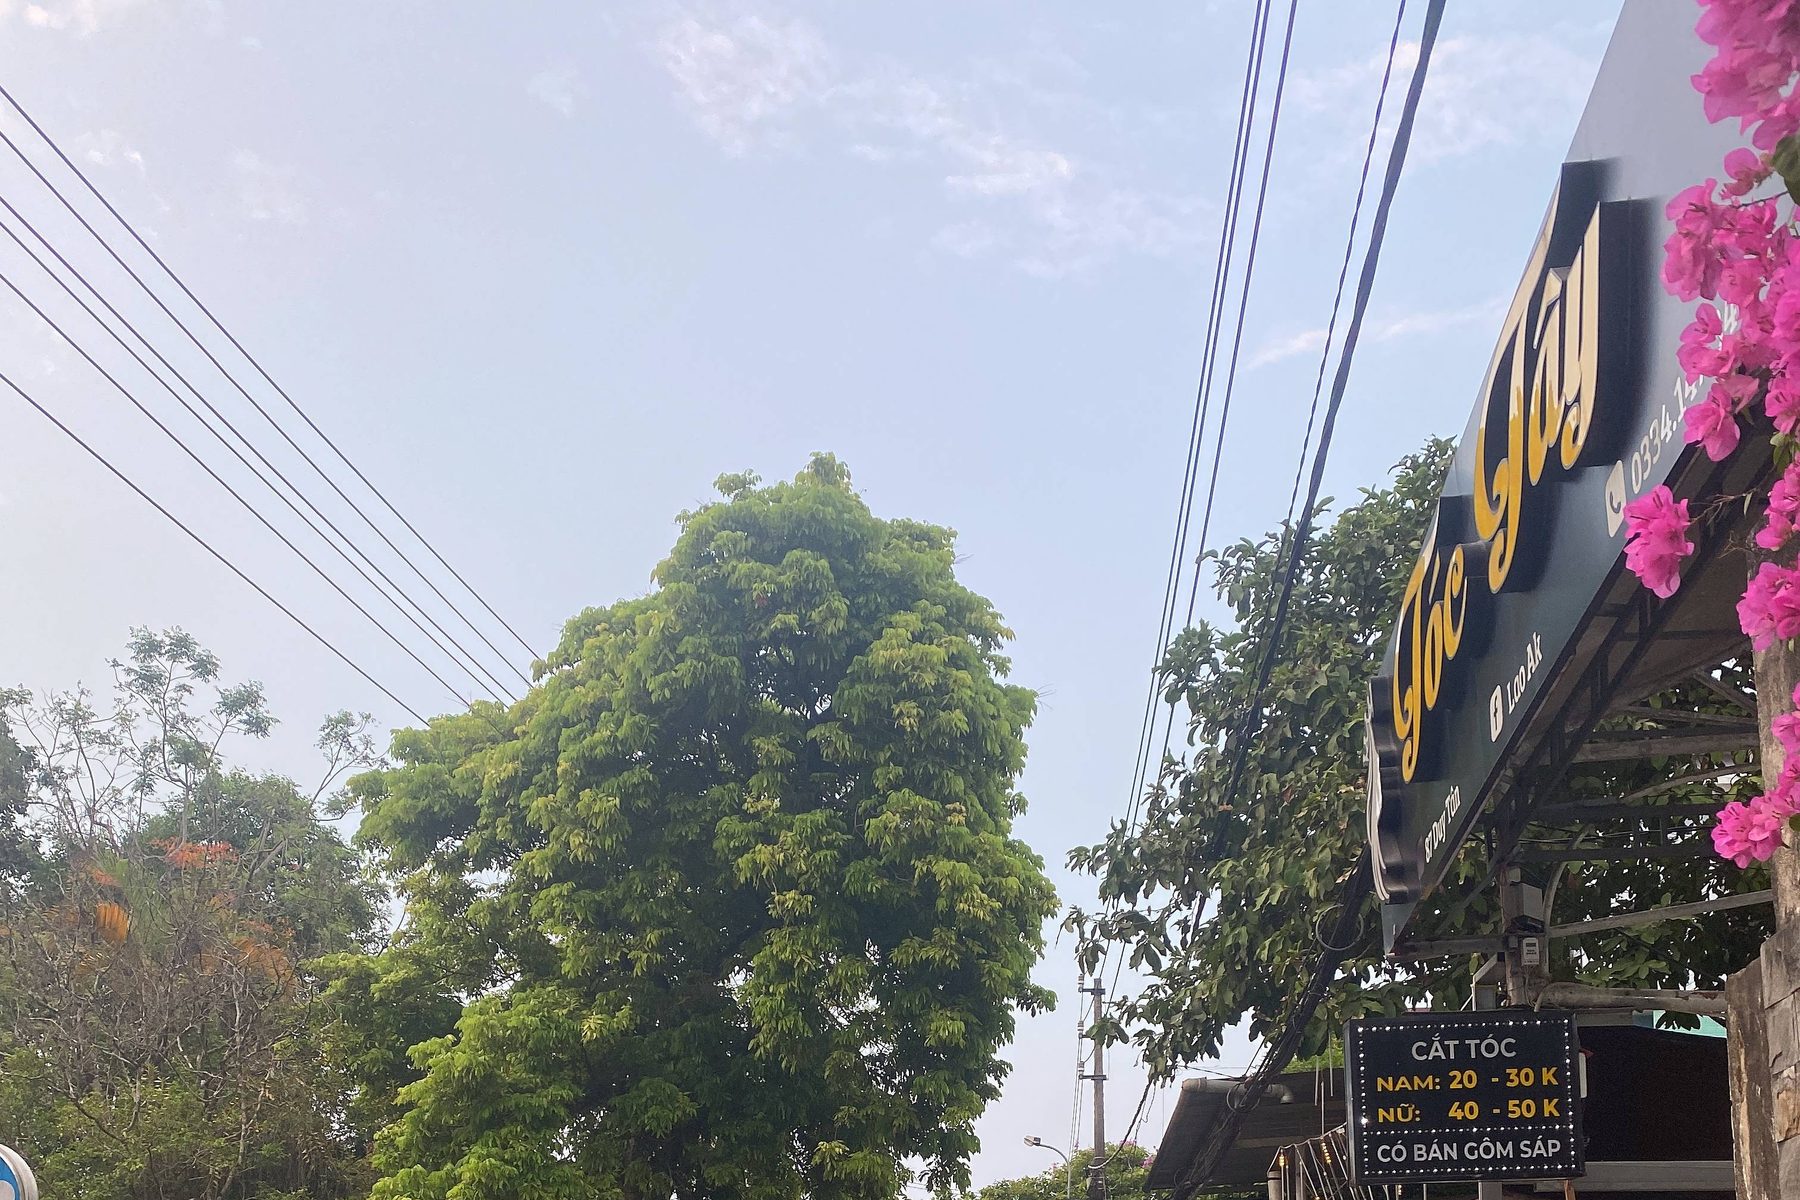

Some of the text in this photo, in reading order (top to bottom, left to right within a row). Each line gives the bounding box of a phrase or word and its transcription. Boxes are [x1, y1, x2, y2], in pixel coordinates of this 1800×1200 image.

[1393, 497, 1468, 784] Tóc
[1411, 1033, 1516, 1061] CẮT TÓC
[1376, 1066, 1559, 1092] NAM: 20 30 K
[1378, 1098, 1560, 1123] NỮ: 40 50 K
[1377, 1135, 1561, 1163] CÓ BÁN GÔM SÁP
